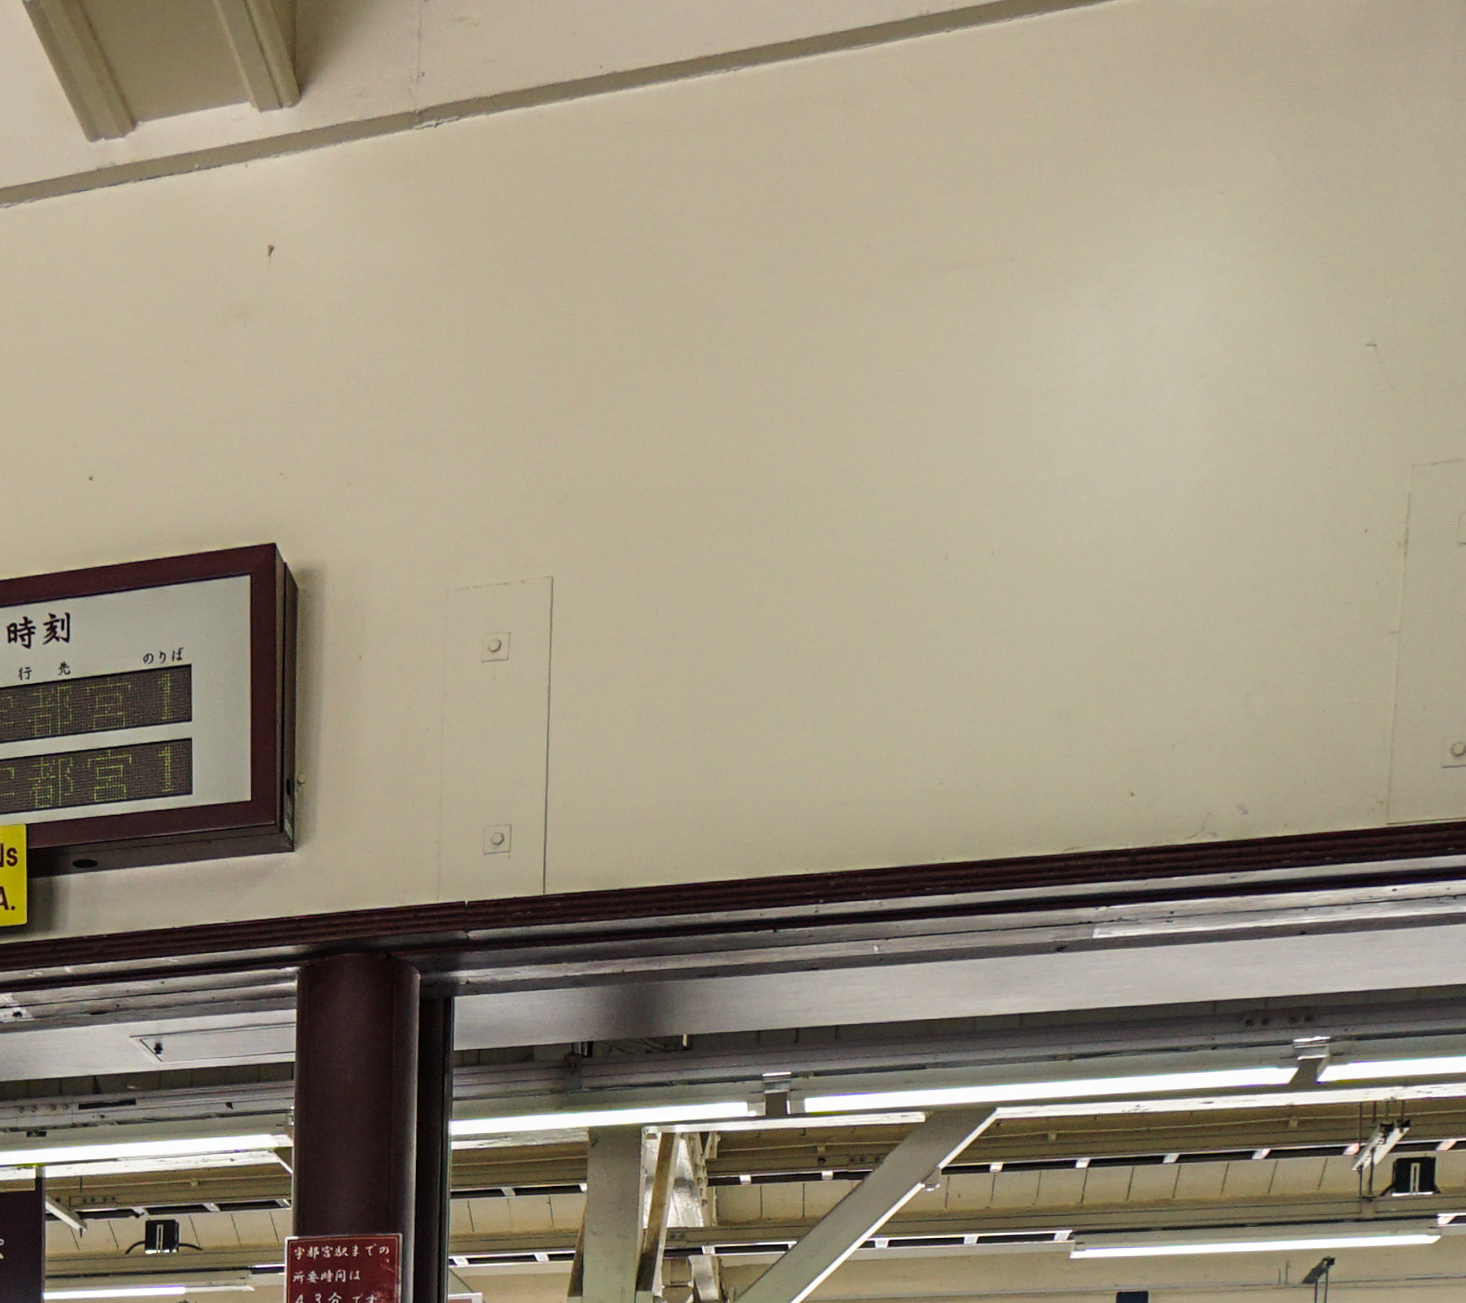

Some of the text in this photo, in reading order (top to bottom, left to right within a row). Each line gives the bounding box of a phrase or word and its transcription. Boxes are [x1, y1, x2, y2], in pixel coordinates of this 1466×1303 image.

[142, 647, 184, 666] のりば
[292, 1269, 361, 1284] 所要時間は
